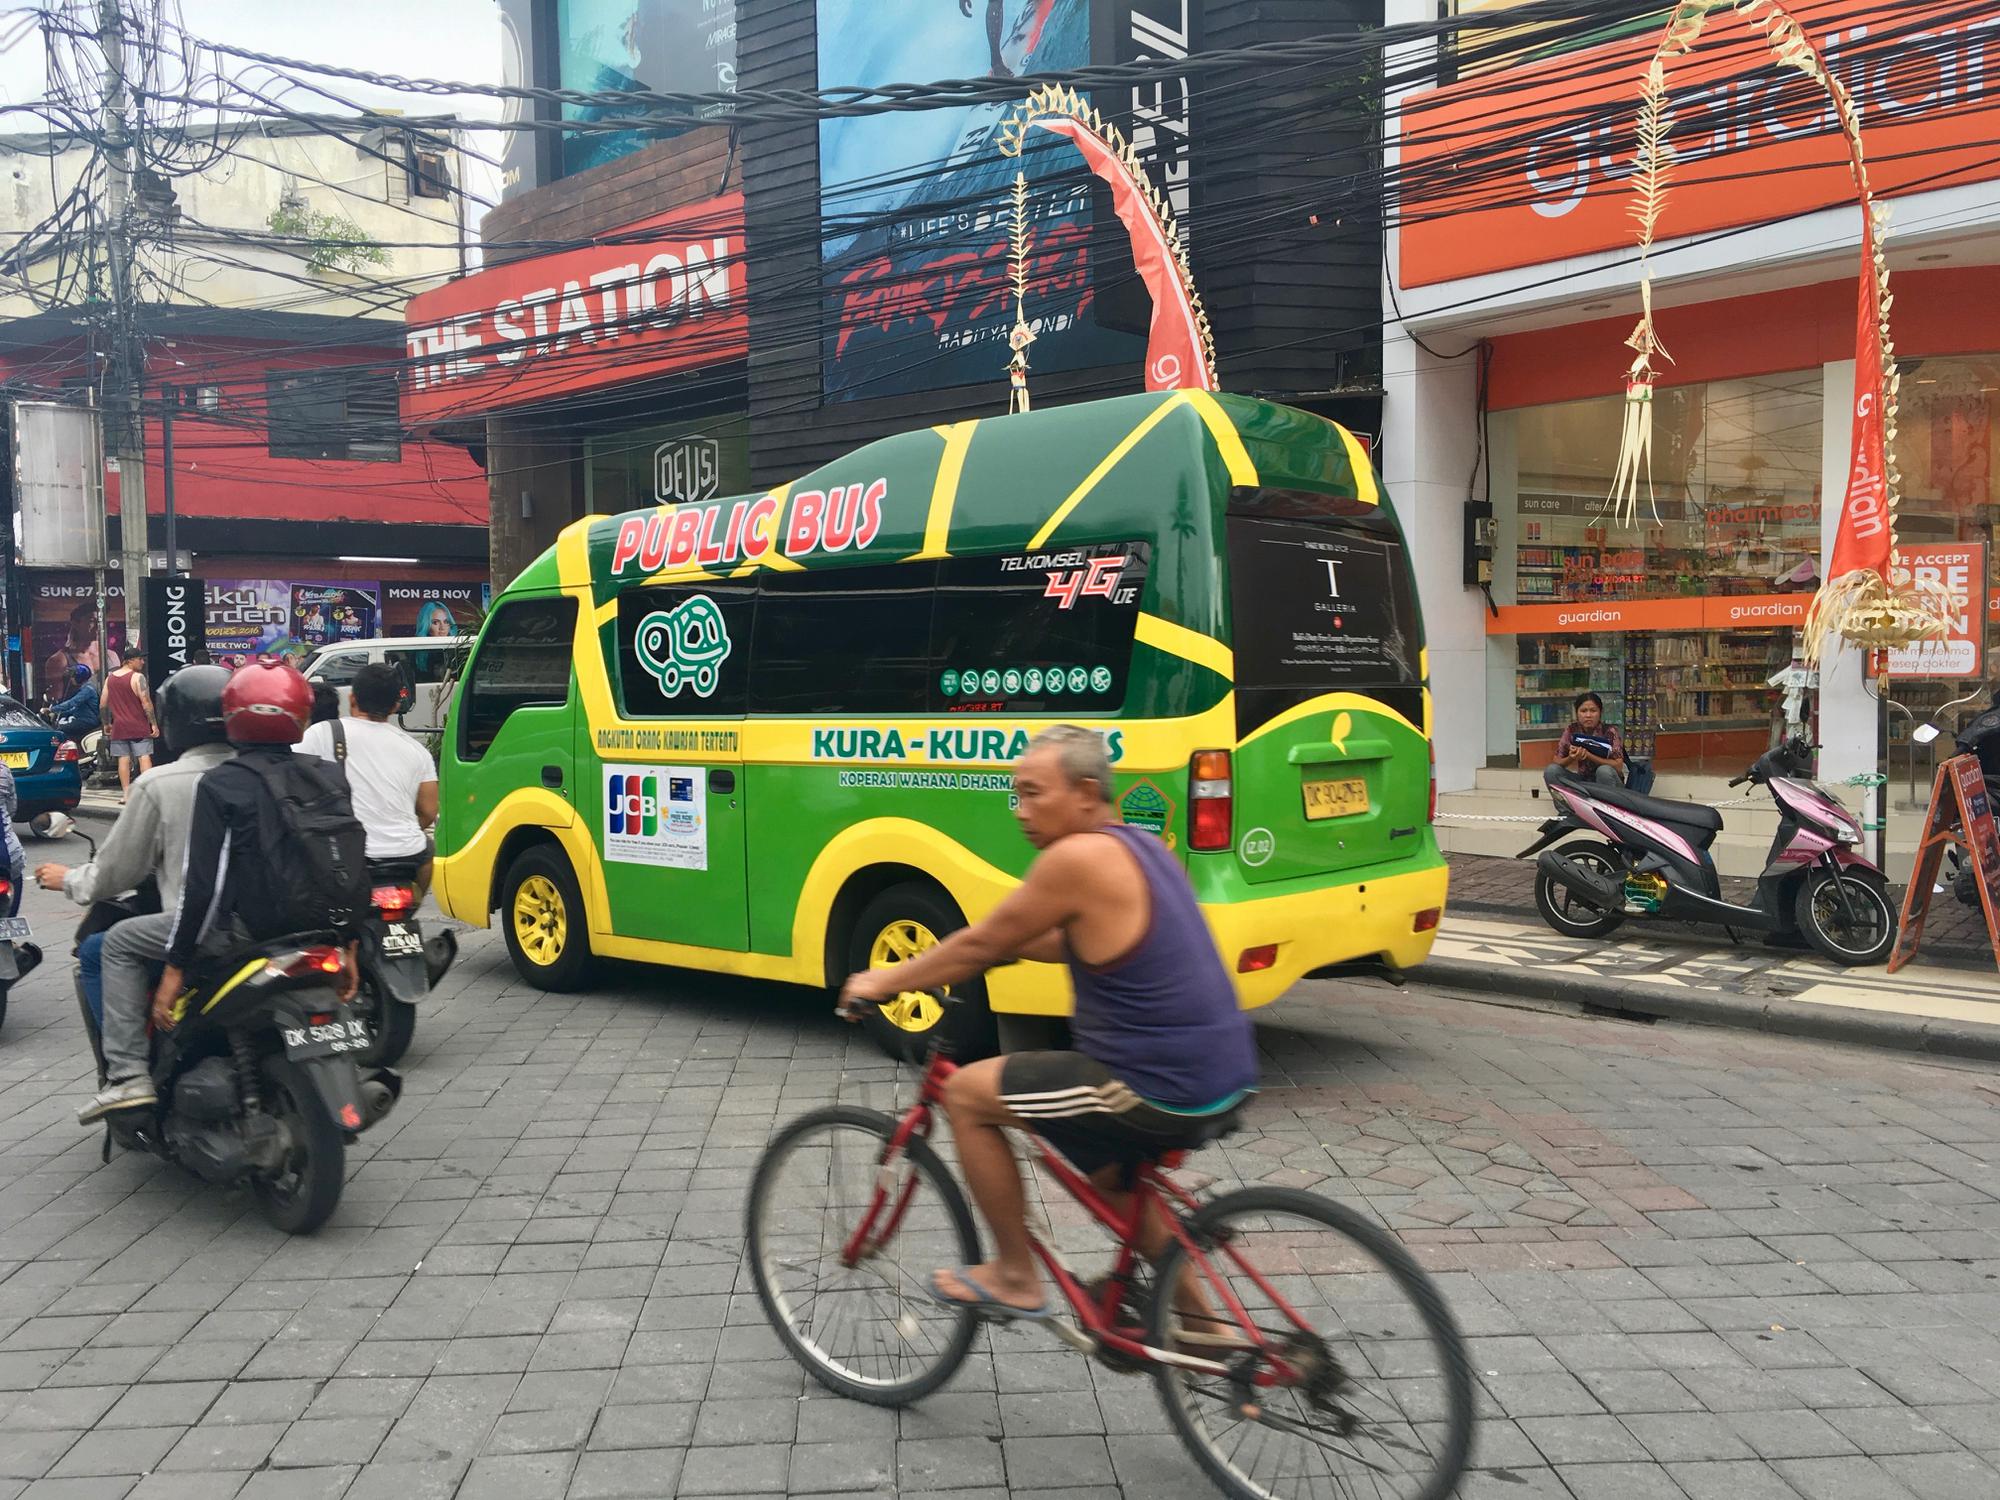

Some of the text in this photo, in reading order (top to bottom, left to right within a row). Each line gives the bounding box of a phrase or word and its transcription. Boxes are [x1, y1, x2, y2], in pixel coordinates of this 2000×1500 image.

[407, 311, 486, 390] THE
[493, 237, 731, 367] STATION
[1028, 313, 1074, 337] ONDI
[611, 477, 887, 575] PUBLIC BUS
[1000, 552, 1084, 571] TELKOMSEL
[1914, 554, 1970, 565] ACCEPT
[41, 586, 72, 598] SUN
[75, 586, 93, 598] 27
[1044, 555, 1126, 610] 4G
[389, 589, 471, 599] MON 28 NOV
[1558, 610, 1621, 626] guardian
[1730, 603, 1803, 620] guardian
[166, 586, 187, 676] ABONG
[598, 729, 738, 752] ANGKUTAN ORANG KAWASAN TERTENTU
[840, 771, 897, 787] KOPERASI
[899, 772, 958, 789] WAHANA
[608, 794, 656, 817] JCB
